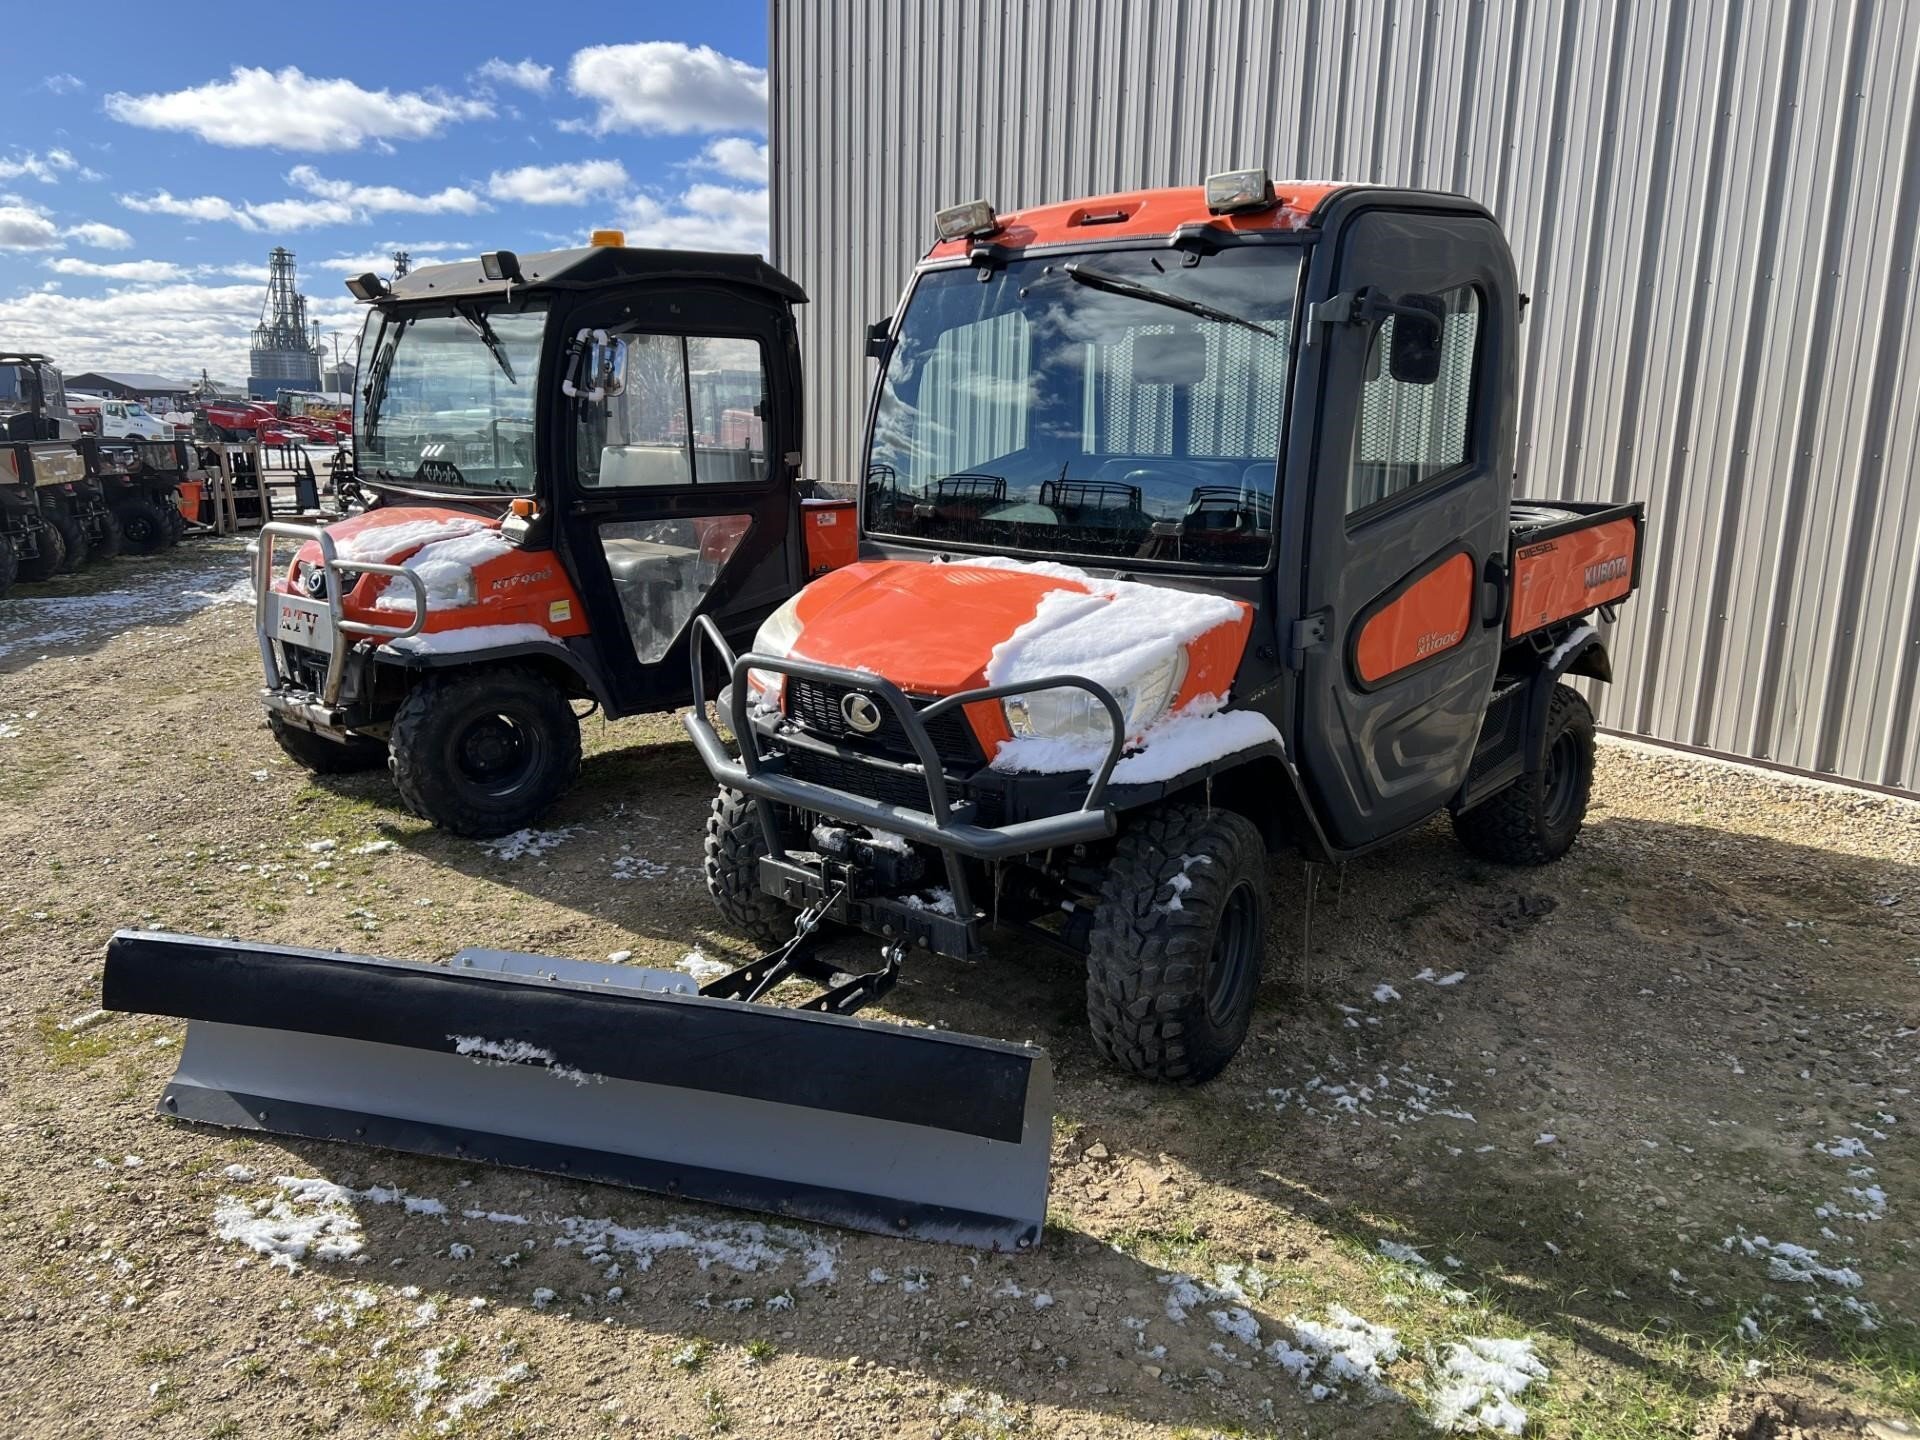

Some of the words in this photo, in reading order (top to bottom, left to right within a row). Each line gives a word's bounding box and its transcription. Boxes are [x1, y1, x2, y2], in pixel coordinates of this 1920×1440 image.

[1518, 542, 1559, 560] DIESEL
[1584, 556, 1628, 589] KUBOTA
[280, 606, 319, 636] RTV
